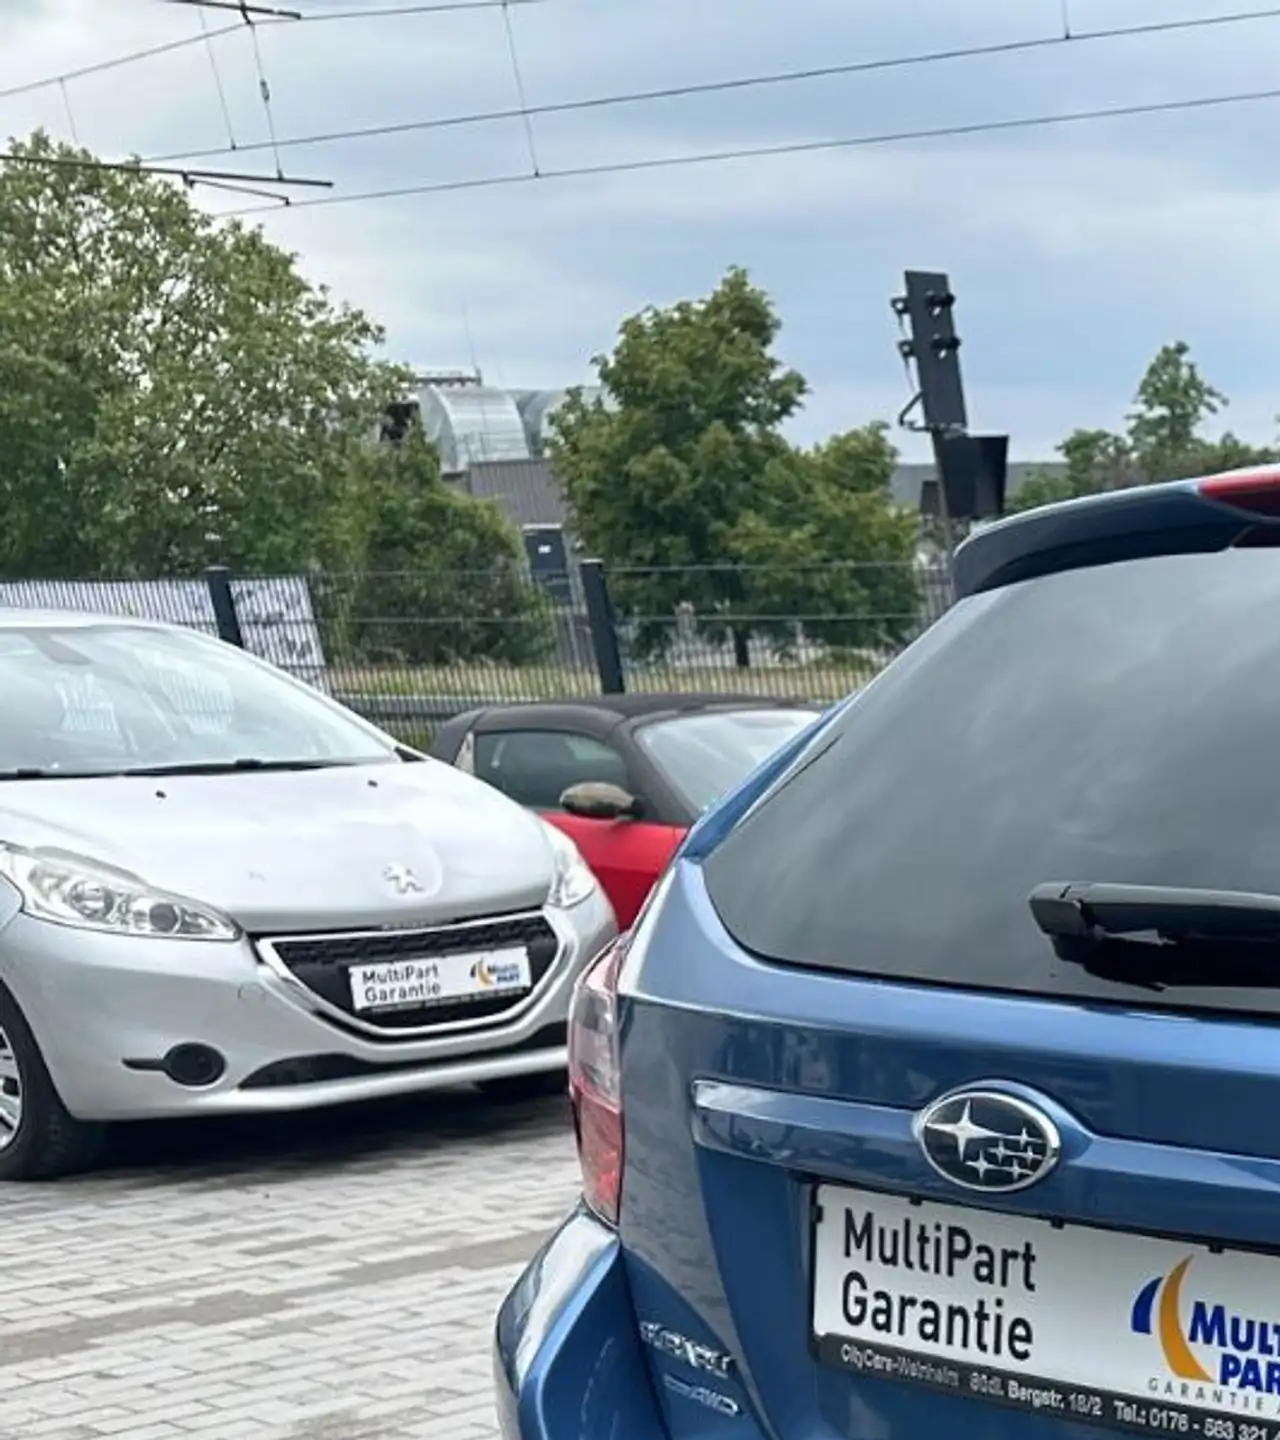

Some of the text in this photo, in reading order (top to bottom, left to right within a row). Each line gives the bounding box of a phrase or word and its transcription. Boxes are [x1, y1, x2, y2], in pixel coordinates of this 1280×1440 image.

[362, 963, 440, 986] MultiPart
[365, 980, 441, 1002] Garantie
[843, 1207, 1037, 1292] MultiPart
[841, 1271, 1034, 1362] Garantie
[1008, 1380, 1065, 1409] Bergstr.
[1113, 1400, 1146, 1425] Tel.:
[1148, 1376, 1264, 1412] GARANTIE
